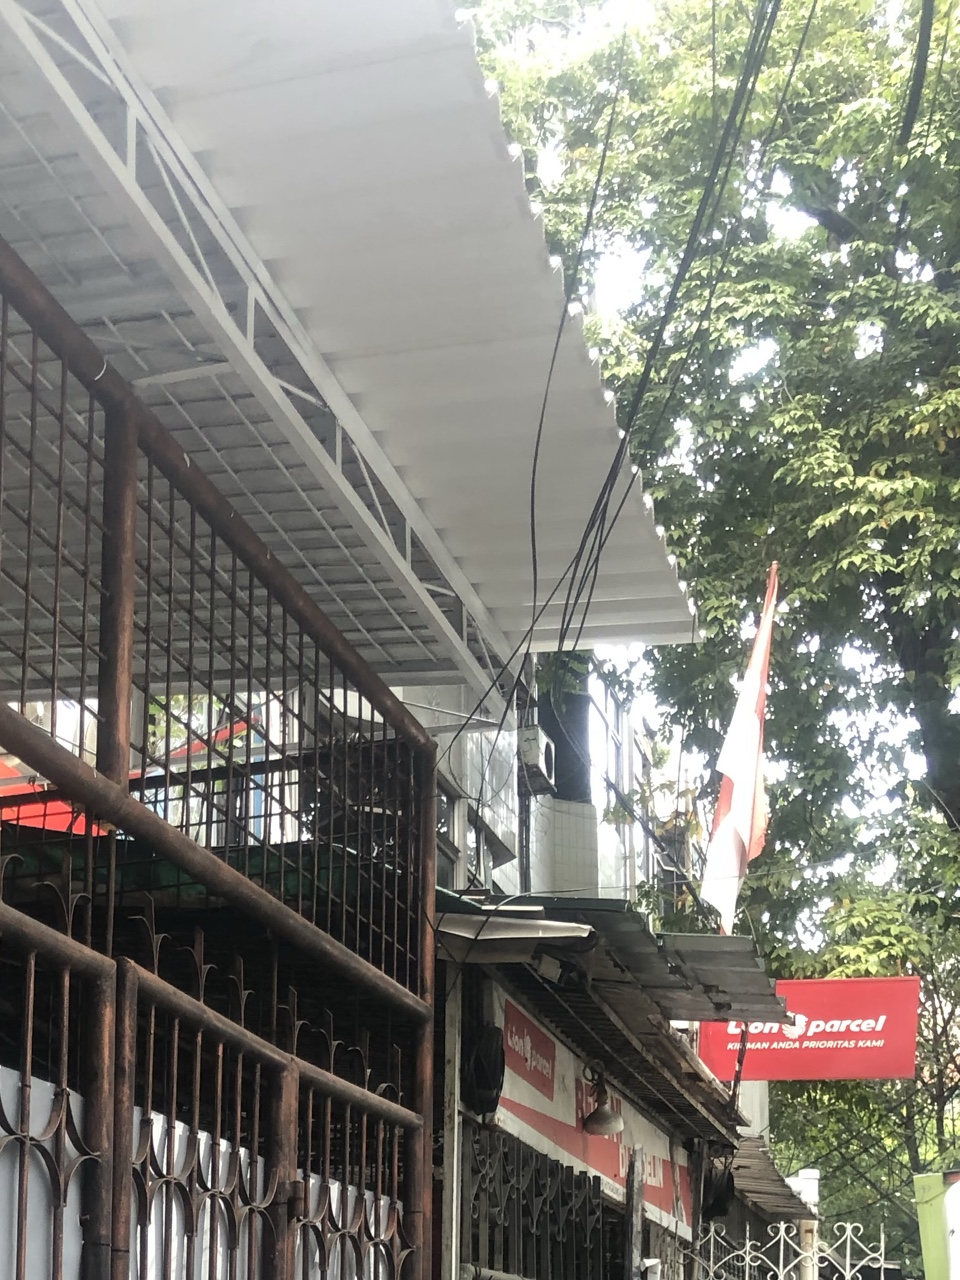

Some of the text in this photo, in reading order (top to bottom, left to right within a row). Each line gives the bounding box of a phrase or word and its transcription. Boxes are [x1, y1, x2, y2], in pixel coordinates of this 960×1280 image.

[727, 1015, 887, 1036] Lon parcel
[727, 1039, 885, 1050] KIMAN ANDA PRIORITAS KAMI
